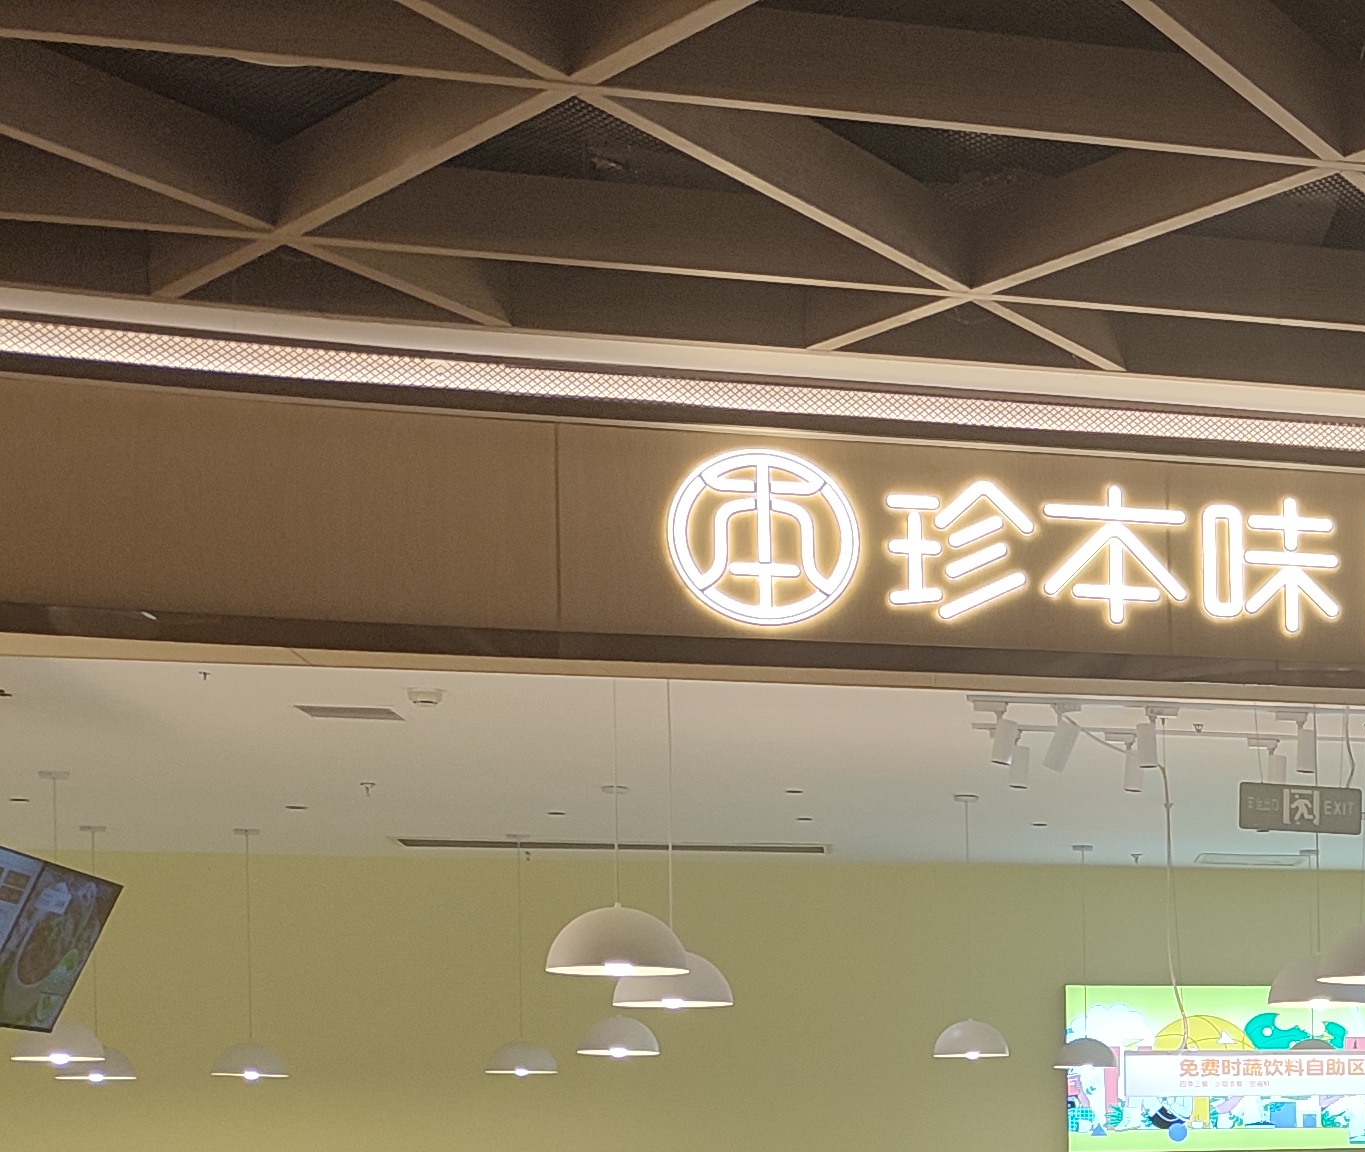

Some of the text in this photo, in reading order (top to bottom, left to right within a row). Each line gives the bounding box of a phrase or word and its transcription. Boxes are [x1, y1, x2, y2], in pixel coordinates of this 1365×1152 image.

[886, 480, 1341, 634] 珍本味
[1323, 800, 1356, 816] EXIT
